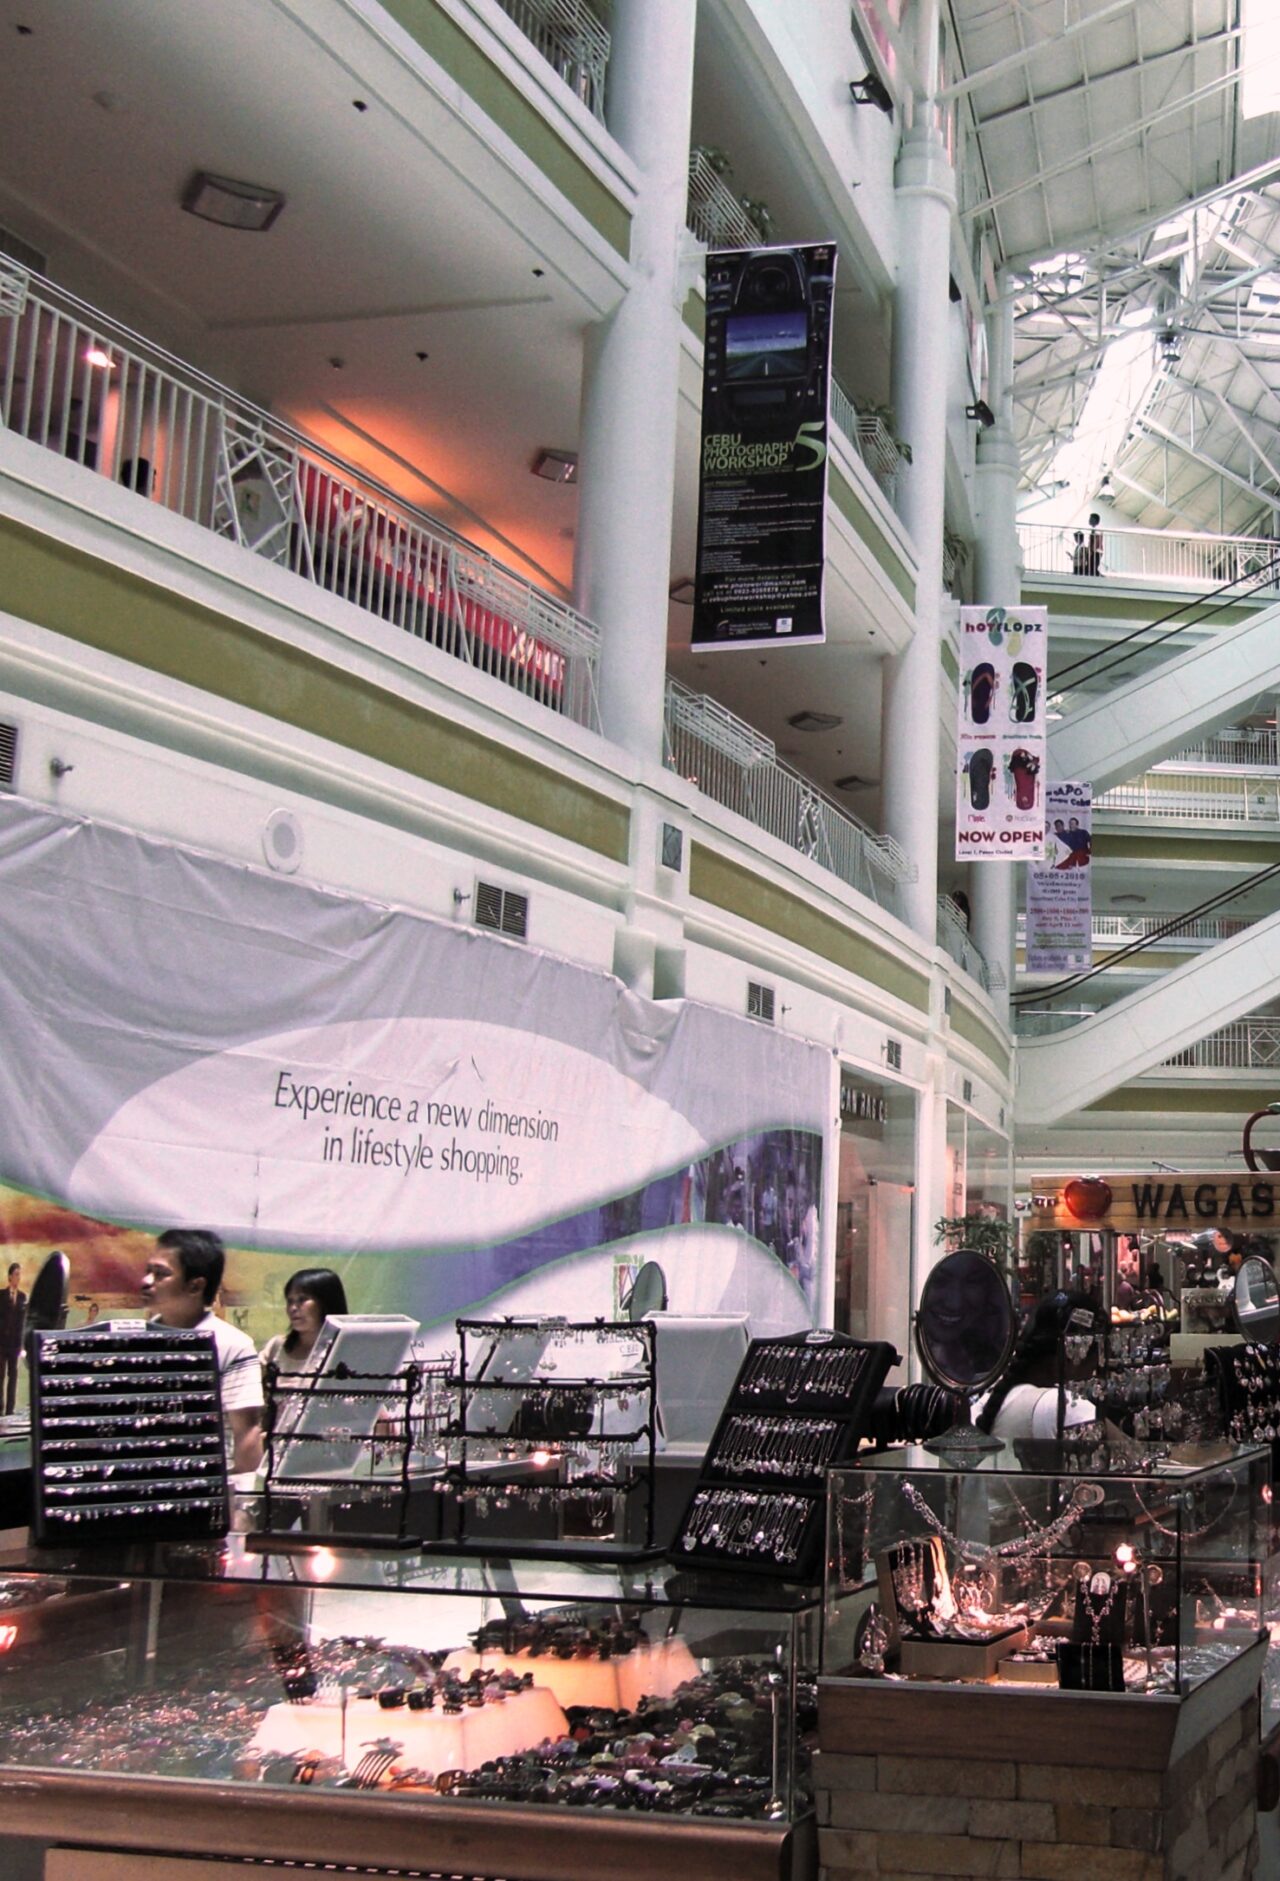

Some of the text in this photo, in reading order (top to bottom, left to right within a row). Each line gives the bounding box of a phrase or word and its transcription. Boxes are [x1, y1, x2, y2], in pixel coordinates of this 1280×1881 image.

[704, 434, 741, 447] CEBU
[704, 441, 796, 458] PHOTOGRAPHY
[795, 421, 827, 471] 5
[703, 453, 787, 471] WORKSHOP
[959, 831, 1043, 843] NOW OPEN
[274, 1071, 560, 1143] Experience a new dimension
[322, 1126, 524, 1187] in lifestyle shopping.
[1131, 1181, 1275, 1219] WAGAS
